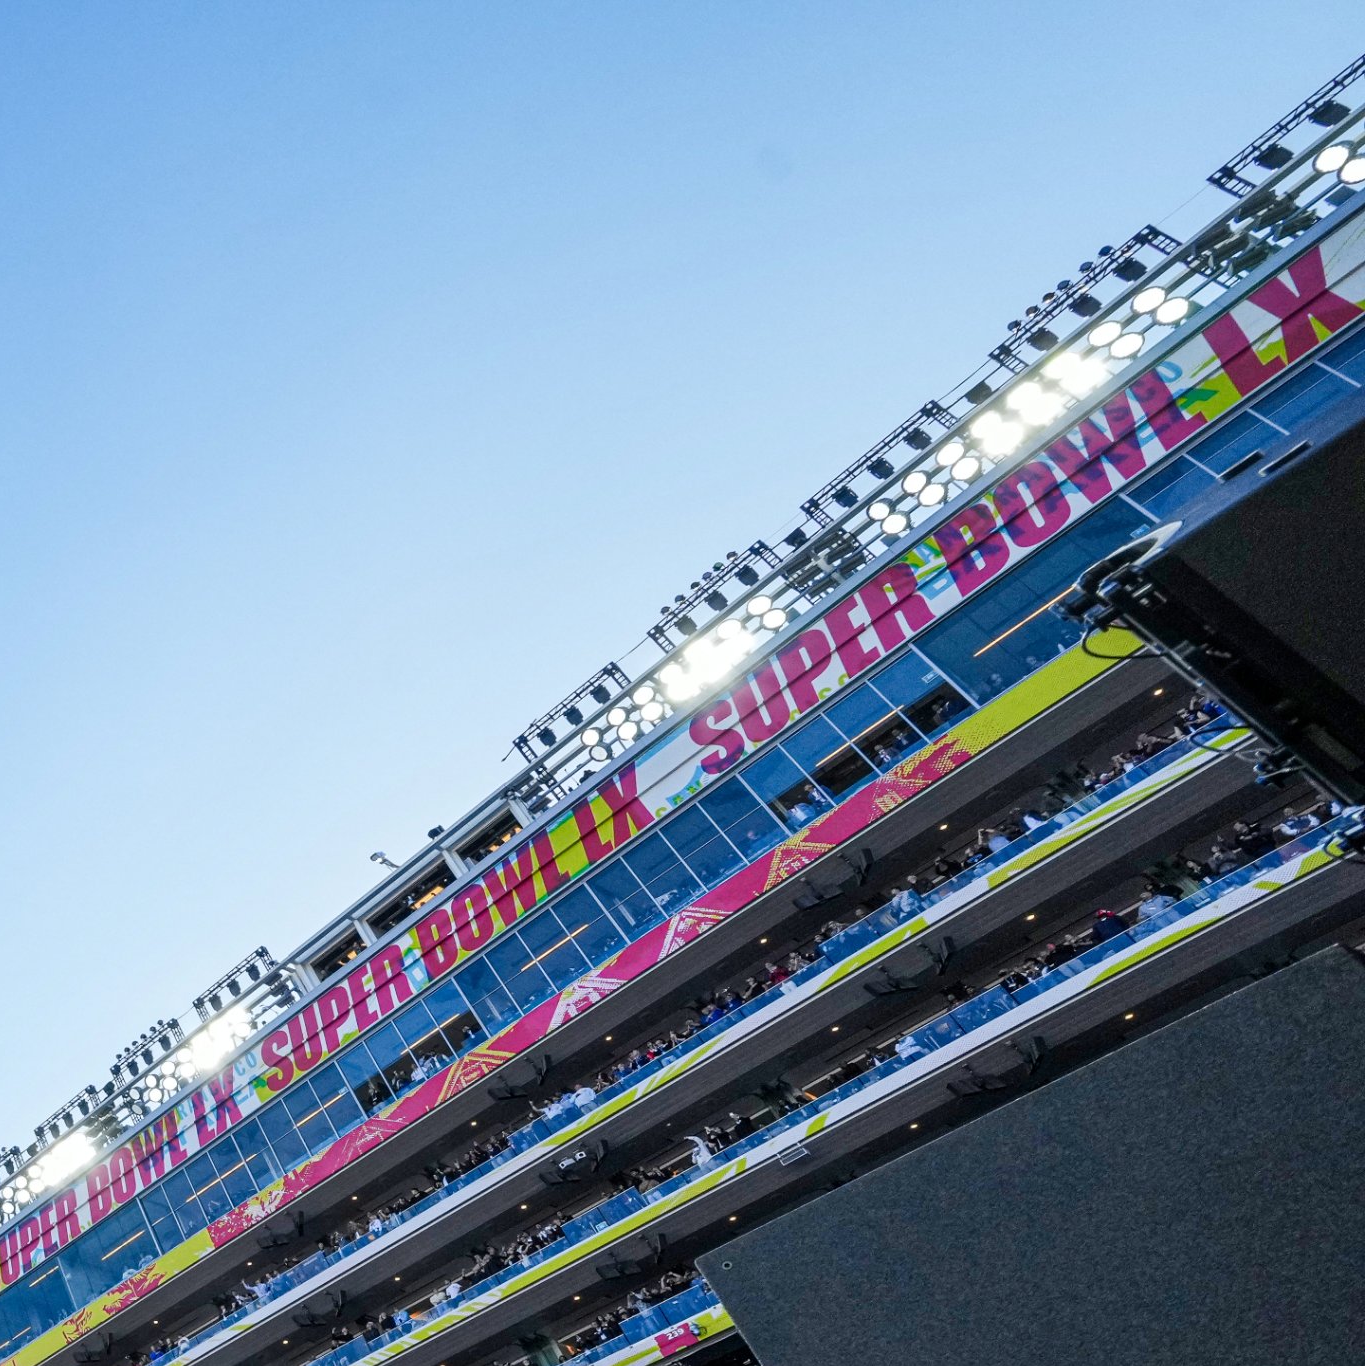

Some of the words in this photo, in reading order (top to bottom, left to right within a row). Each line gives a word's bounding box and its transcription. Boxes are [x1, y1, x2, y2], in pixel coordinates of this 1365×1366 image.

[689, 562, 936, 775] SUPER
[932, 372, 1208, 598] BOWL
[1202, 246, 1364, 398] LX
[260, 943, 415, 1092] SUPER
[415, 830, 571, 978] BOWL
[573, 761, 654, 864] LX
[86, 1108, 188, 1225] BOWL
[191, 1066, 243, 1148] LX
[667, 1328, 684, 1341] 239
